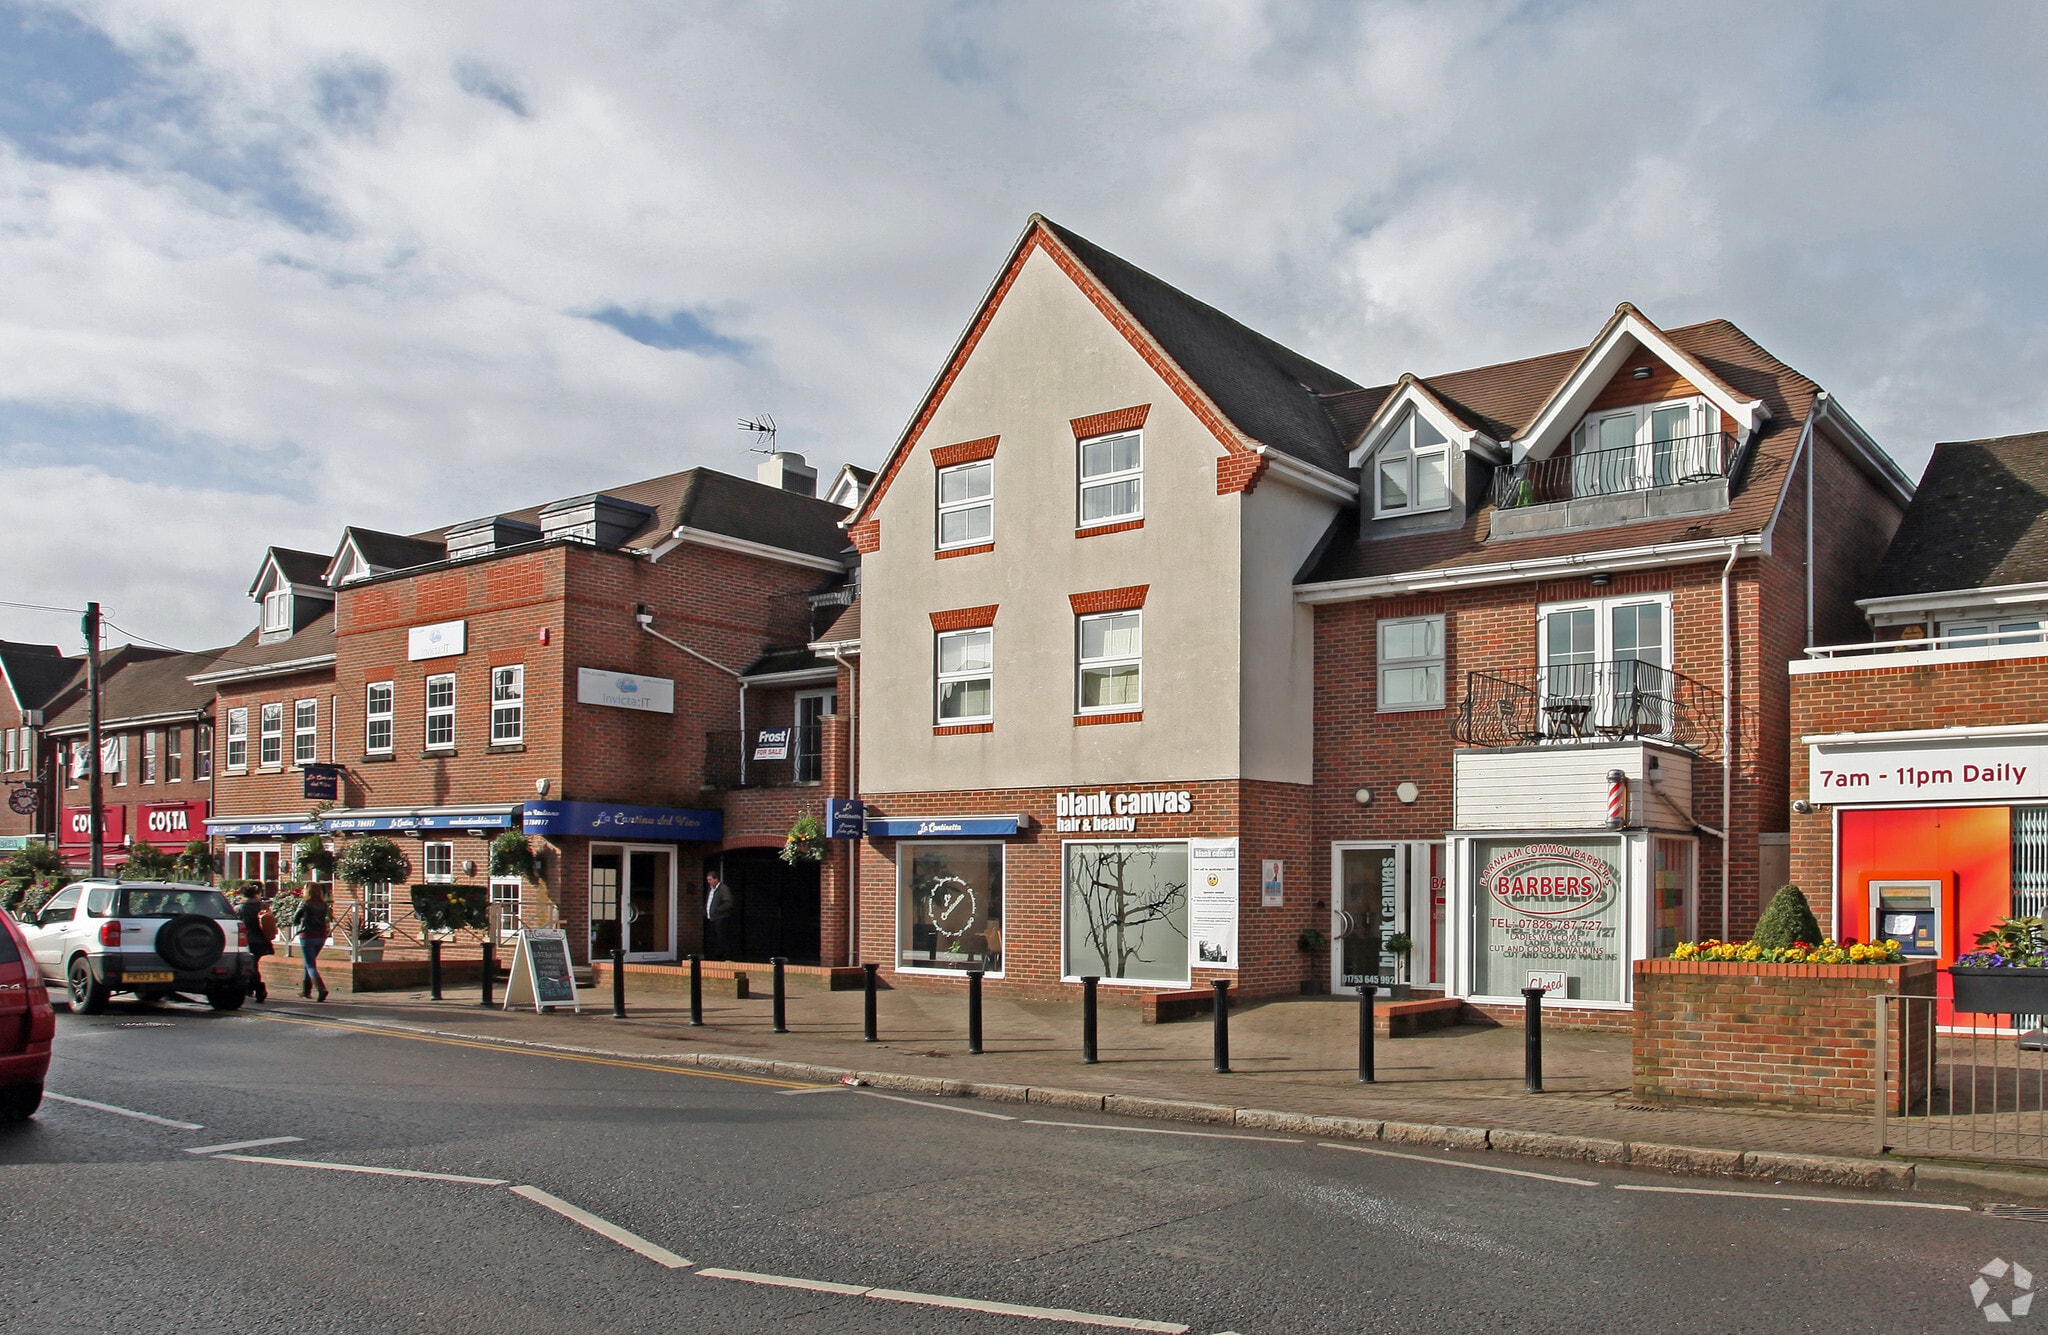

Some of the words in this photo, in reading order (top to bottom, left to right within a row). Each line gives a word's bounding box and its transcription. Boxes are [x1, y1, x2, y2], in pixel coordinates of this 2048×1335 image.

[758, 730, 786, 743] Frost
[1820, 770, 1870, 788] 7am
[1896, 767, 1953, 788] 11pm
[1963, 763, 2027, 785] Daily
[1056, 790, 1113, 816] blank
[1115, 791, 1191, 815] canvas
[149, 811, 188, 833] COSTA
[592, 811, 611, 827] La
[614, 812, 654, 825] Cantina
[657, 815, 672, 826] del
[675, 815, 701, 827] Vino
[1056, 817, 1082, 832] hair
[1082, 818, 1092, 832] &
[1093, 816, 1136, 832] beauty
[917, 822, 929, 835] La
[929, 822, 962, 833] Cantinetta
[1480, 848, 1523, 886] FARNHAM
[1525, 844, 1572, 856] COMMON
[1574, 849, 1613, 887] BARBERS
[1381, 857, 1395, 918] canvas
[1498, 876, 1593, 896] BARBERS
[1490, 918, 1515, 928] TEL:
[1519, 919, 1553, 930] 07826
[1557, 920, 1577, 930] 787
[1581, 921, 1602, 931] 727
[1510, 933, 1537, 941] LADIES
[1507, 945, 1525, 953] AND
[1364, 975, 1379, 984] 645
[1380, 975, 1395, 985] 992
[1529, 974, 1563, 993] Closed
